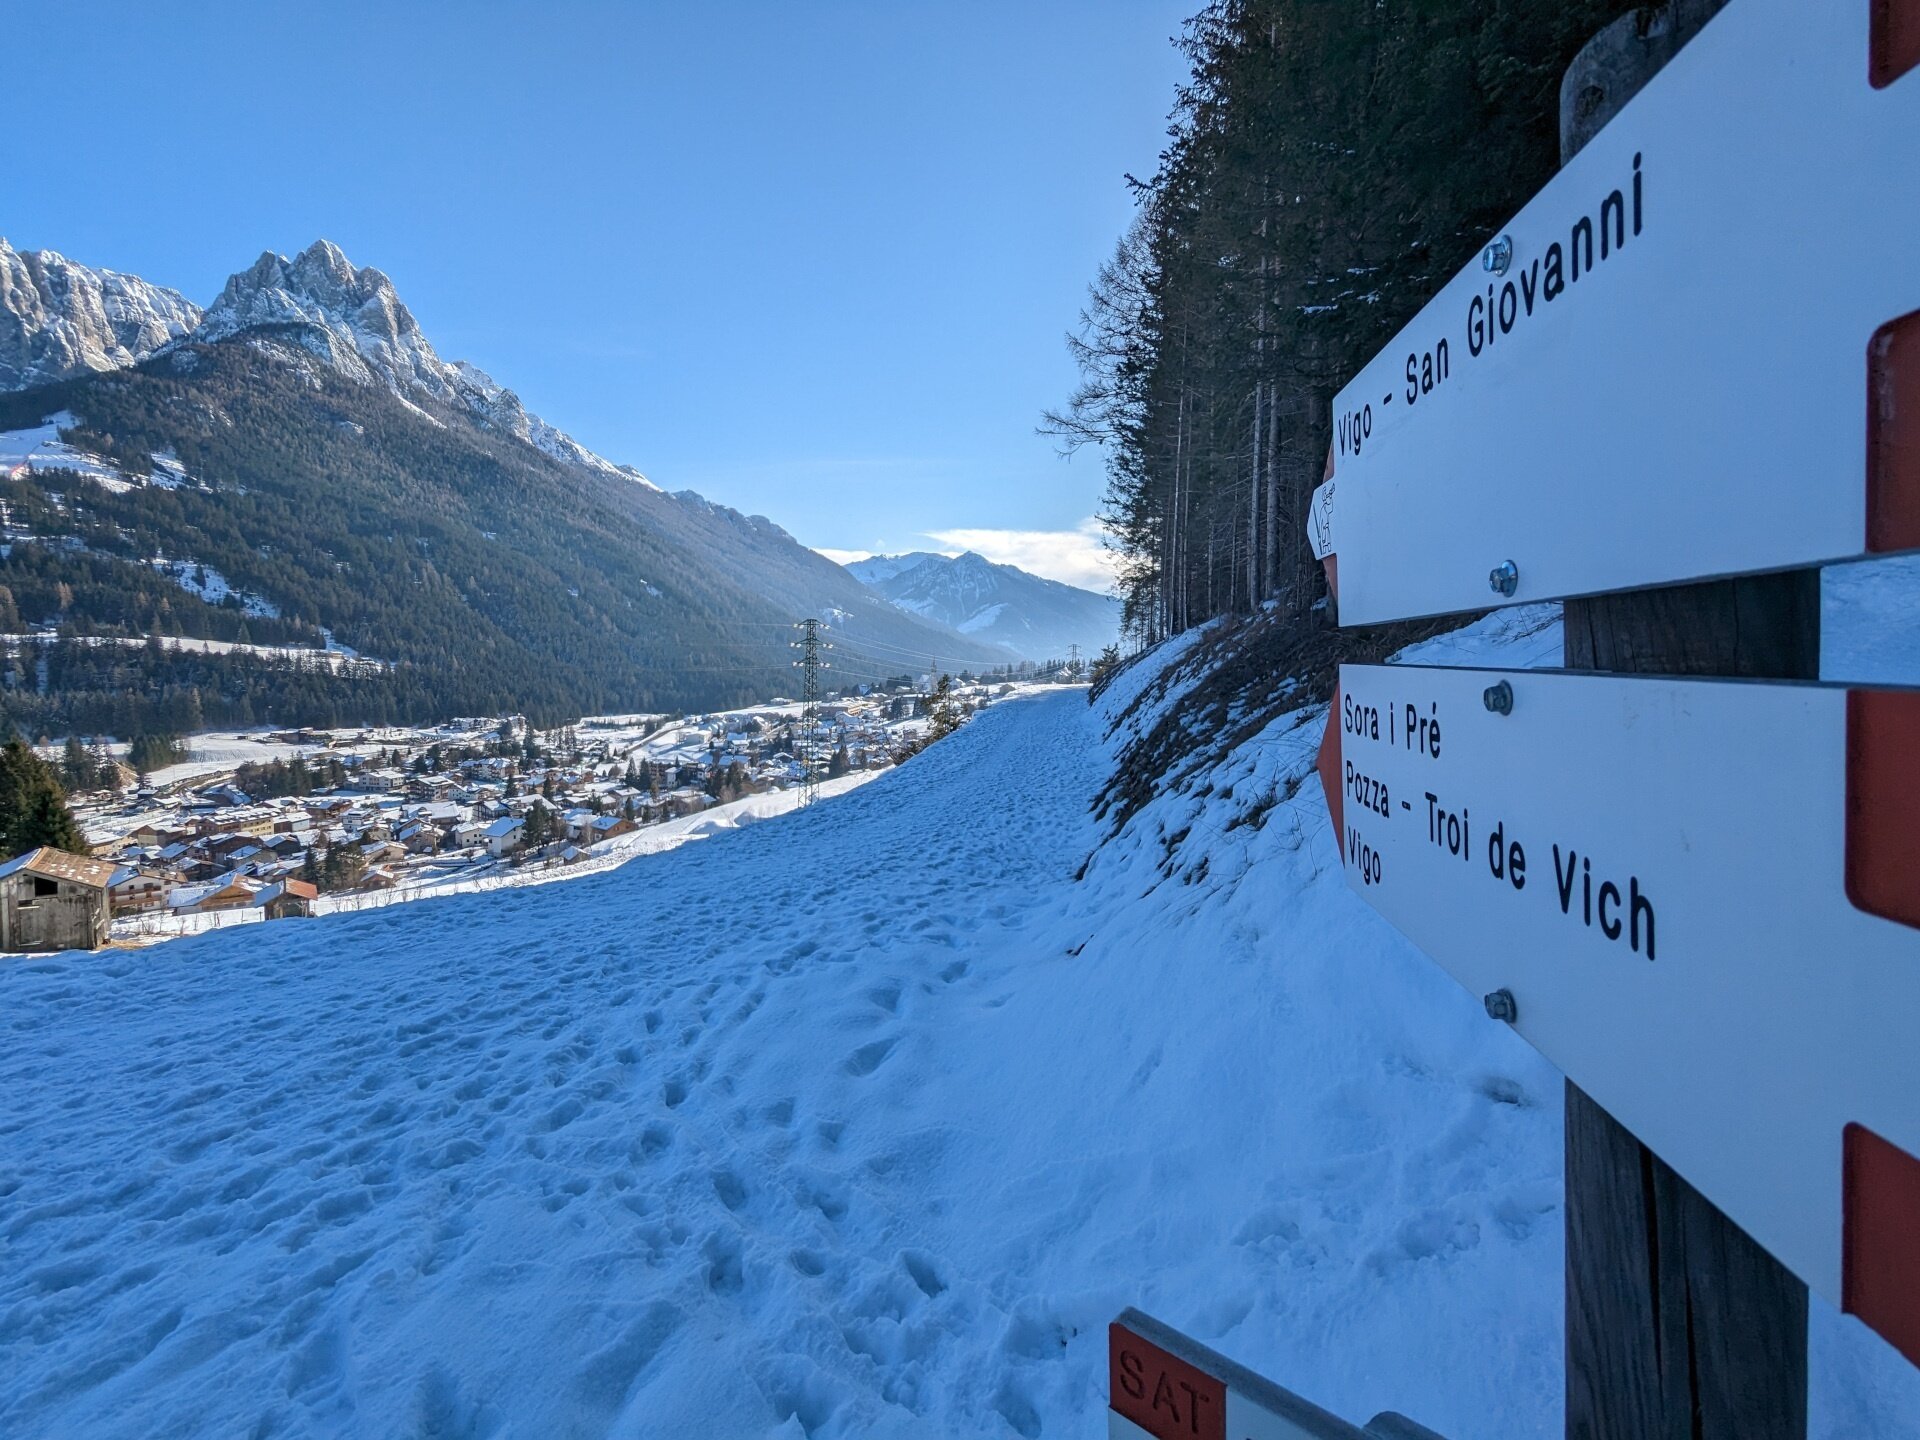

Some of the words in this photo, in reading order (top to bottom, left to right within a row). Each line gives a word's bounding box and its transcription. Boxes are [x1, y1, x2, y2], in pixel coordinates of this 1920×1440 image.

[1338, 403, 1372, 456] Vigo
[1406, 337, 1449, 405] San
[1467, 151, 1643, 358] Giovanni
[1345, 693, 1380, 741] Sora
[1390, 701, 1394, 746] i
[1406, 701, 1441, 759] Pré
[1346, 759, 1390, 819] Pozza
[1425, 791, 1469, 862] Troi
[1488, 821, 1526, 890] de
[1552, 843, 1656, 962] Vich
[1347, 825, 1381, 885] Vigo
[1119, 1349, 1210, 1435] SAT
